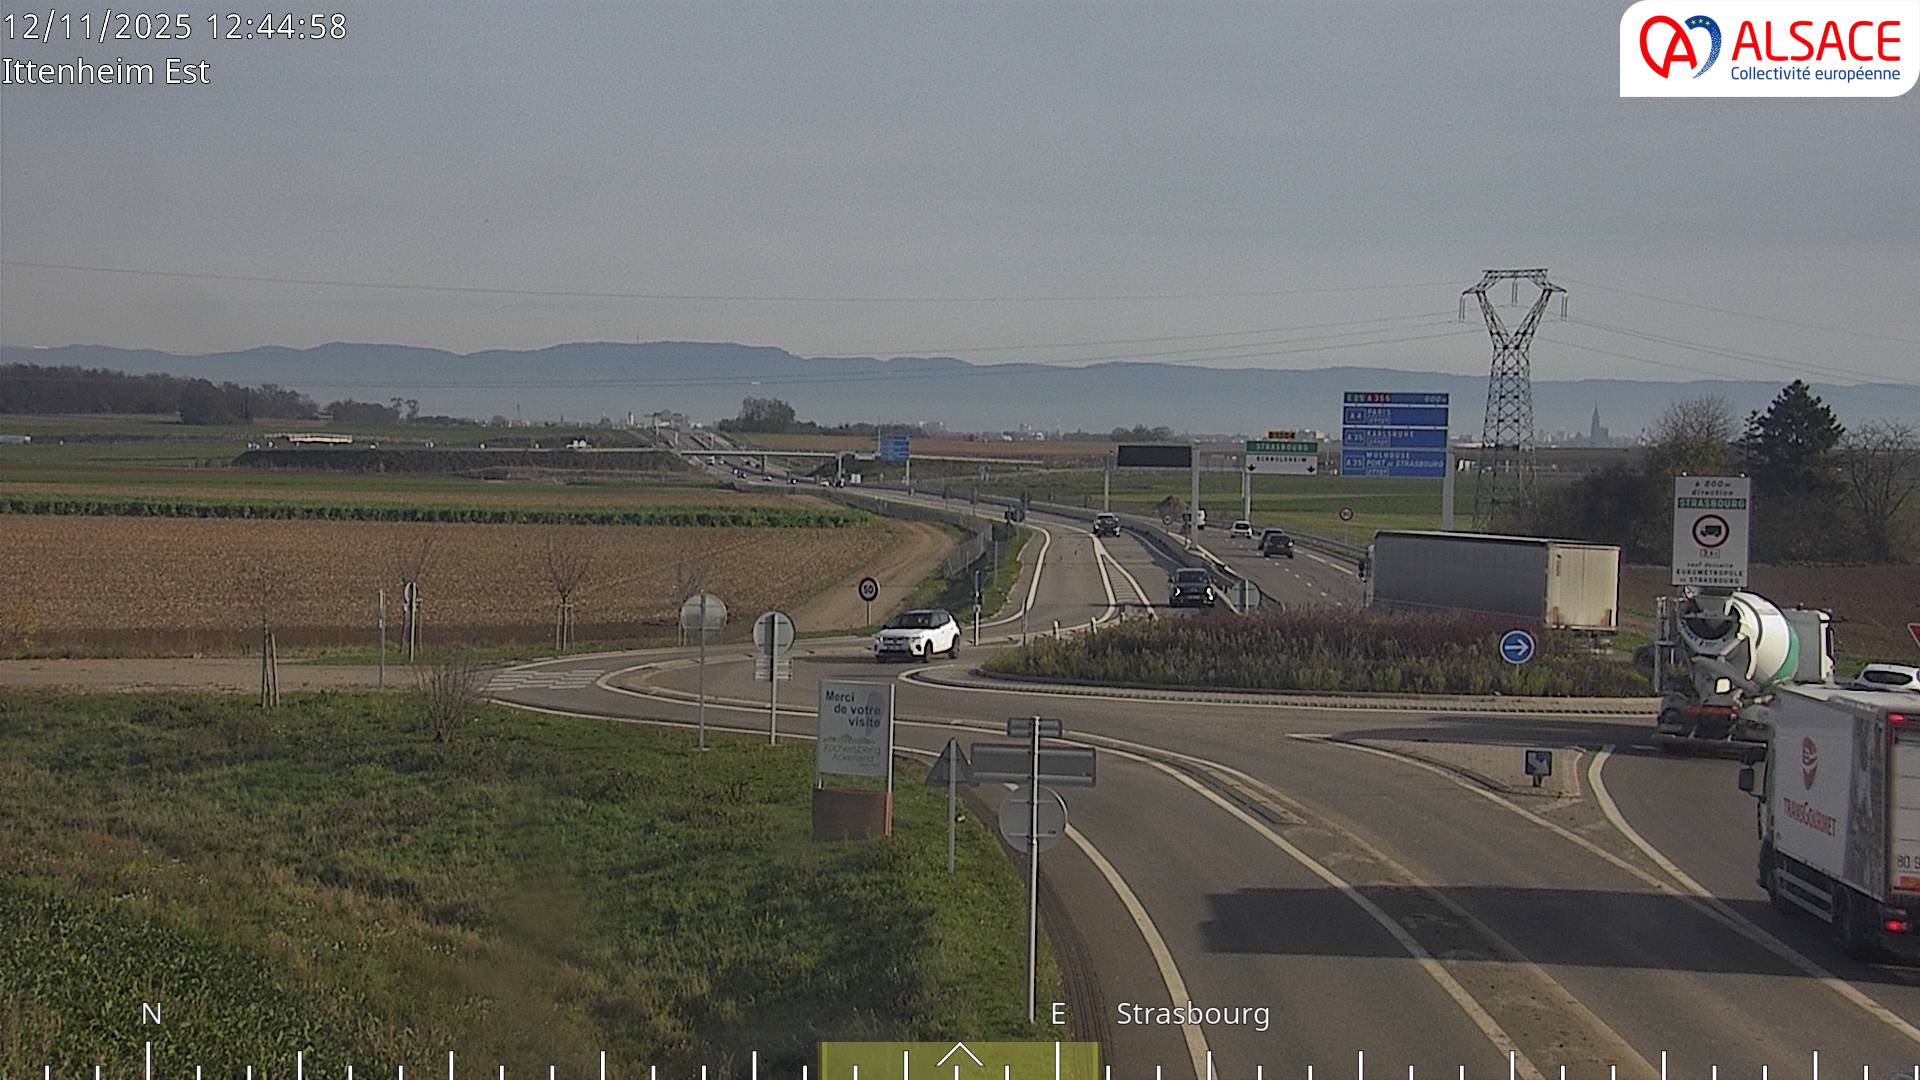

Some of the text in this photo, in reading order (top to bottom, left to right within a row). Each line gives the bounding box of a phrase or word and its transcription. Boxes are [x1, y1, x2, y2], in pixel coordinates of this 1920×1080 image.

[1679, 499, 1746, 508] STRASBOURG
[825, 690, 855, 702] Merci
[834, 703, 881, 715] de votre
[848, 716, 881, 727] visite
